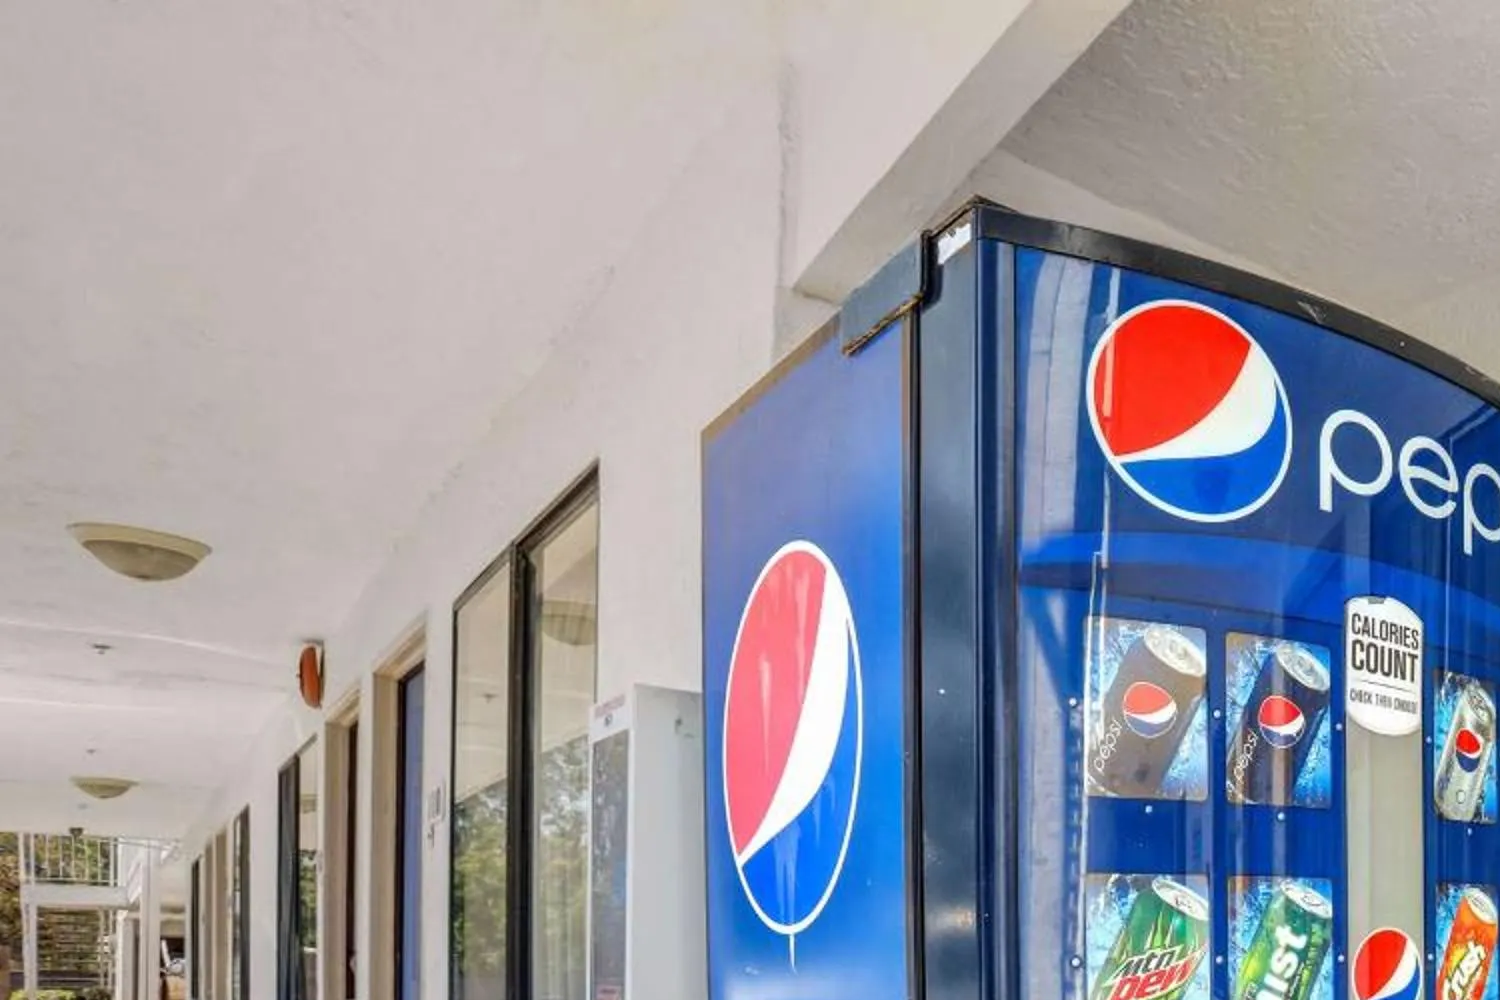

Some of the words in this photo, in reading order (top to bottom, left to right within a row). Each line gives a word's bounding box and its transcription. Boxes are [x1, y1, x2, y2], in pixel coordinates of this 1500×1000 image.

[1351, 612, 1420, 651] CALORIES
[1351, 638, 1419, 684] COUNT
[1093, 716, 1123, 777] pepsi
[1233, 727, 1260, 785] pepsi
